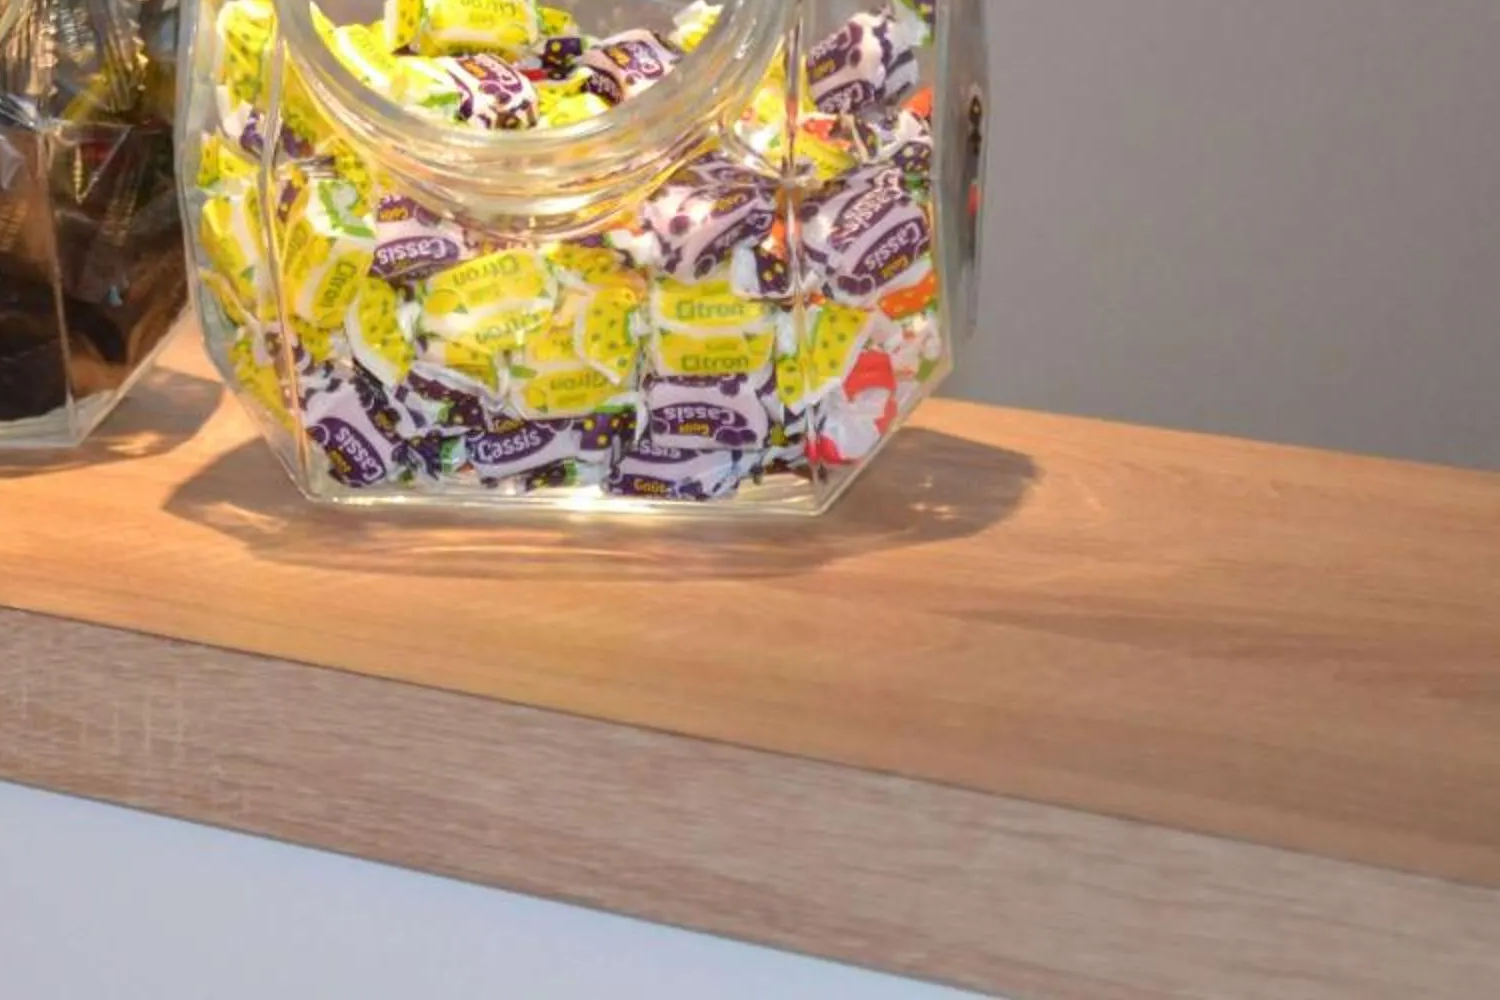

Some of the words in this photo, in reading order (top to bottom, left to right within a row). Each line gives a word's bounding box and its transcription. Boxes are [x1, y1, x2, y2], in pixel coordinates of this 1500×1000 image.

[376, 237, 448, 266] Cassis
[864, 220, 921, 270] Cassis
[452, 254, 520, 287] Citron
[676, 299, 746, 320] Citron
[680, 355, 749, 371] Citron
[663, 406, 736, 426] Cassis
[335, 426, 384, 479] Cassis
[477, 427, 541, 461] Cassis
